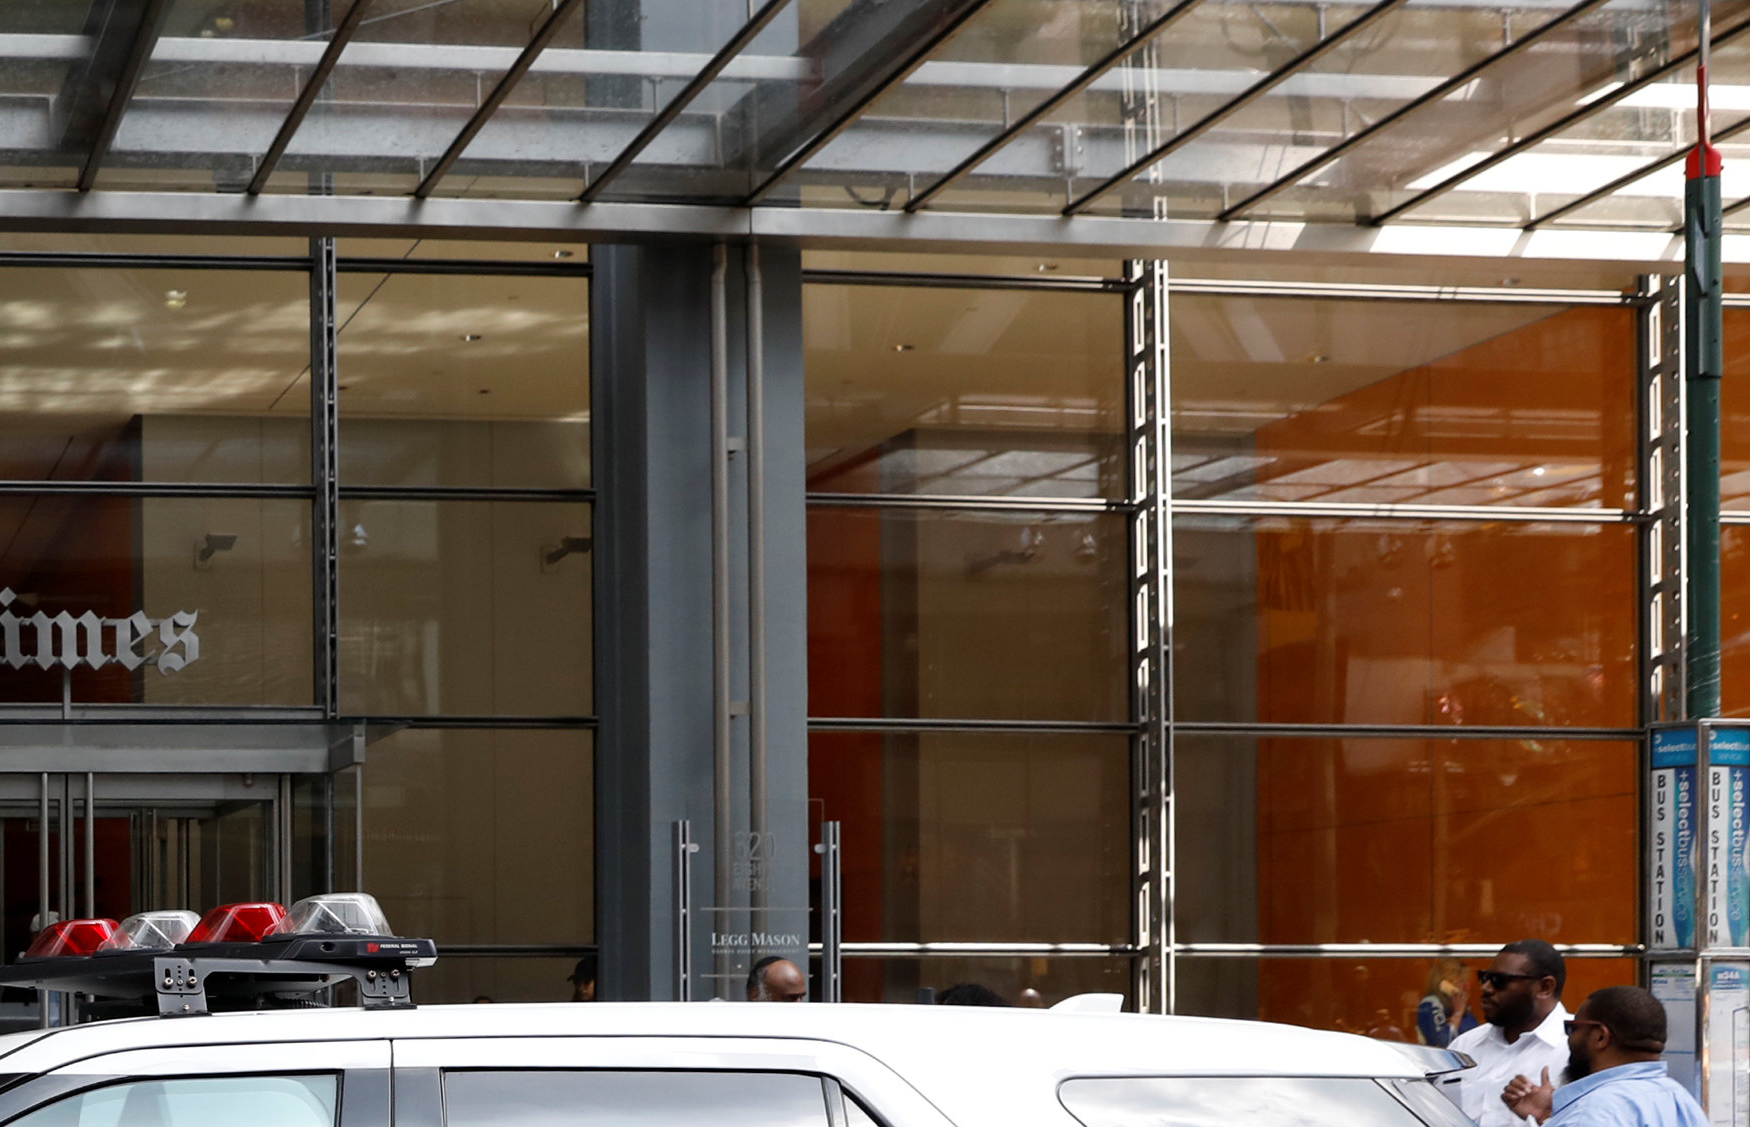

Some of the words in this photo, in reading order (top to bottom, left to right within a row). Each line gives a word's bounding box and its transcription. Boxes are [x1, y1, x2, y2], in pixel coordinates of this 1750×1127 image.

[1656, 774, 1666, 821] BUS
[1711, 771, 1721, 819] BUS
[1655, 832, 1665, 943] STATION
[1710, 830, 1719, 943] STATION
[711, 932, 748, 946] LEGG
[751, 932, 800, 946] MASON
